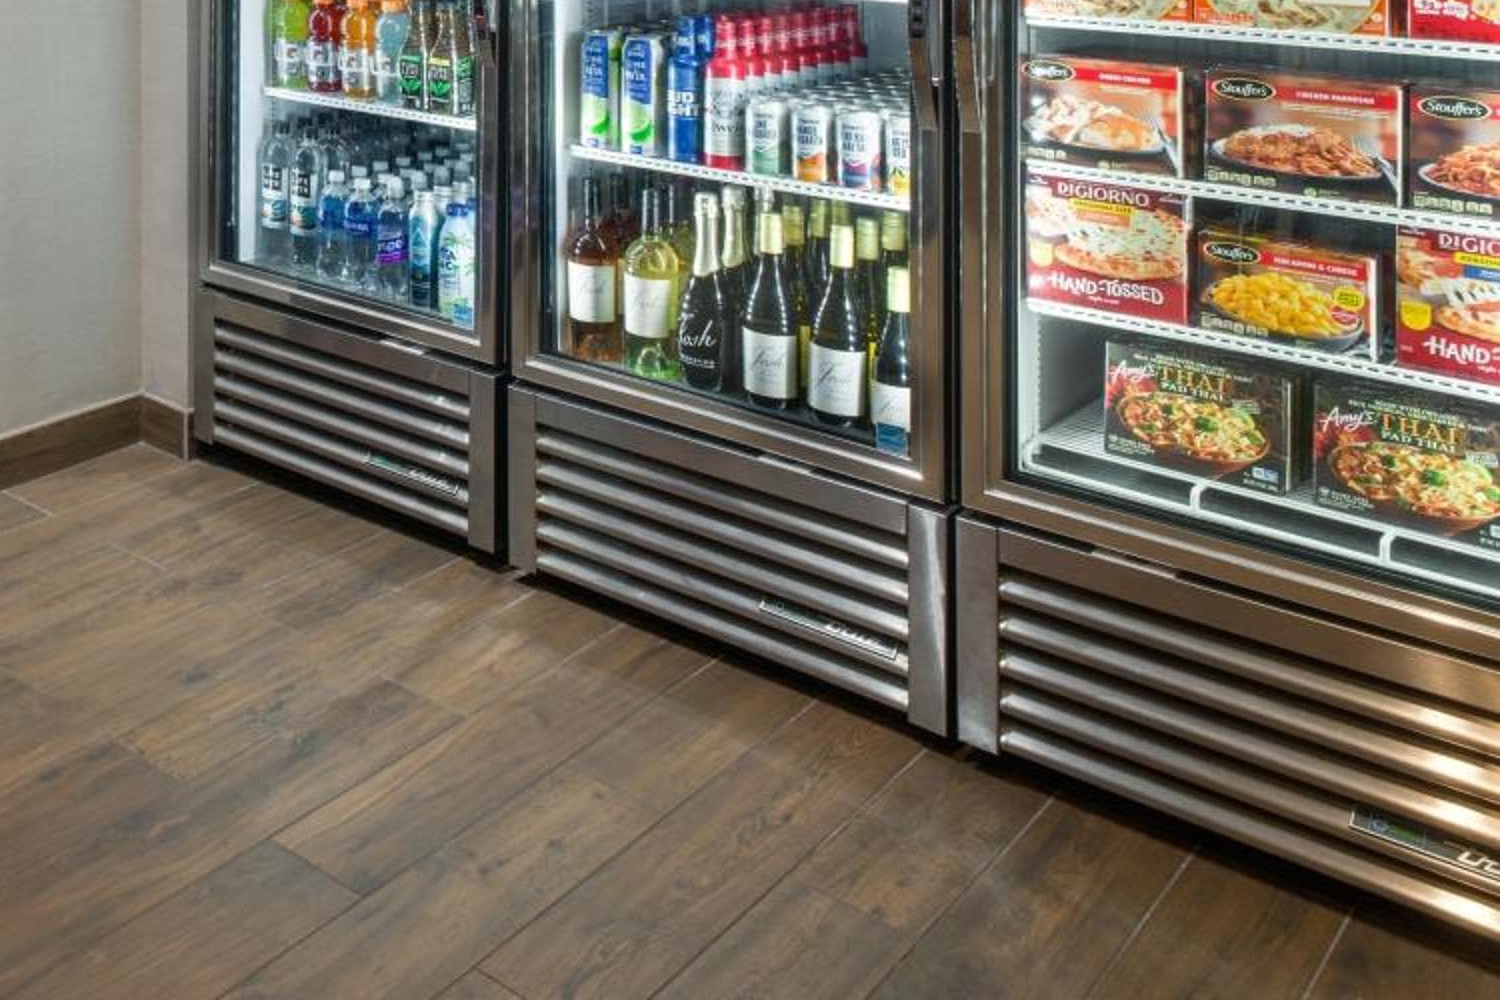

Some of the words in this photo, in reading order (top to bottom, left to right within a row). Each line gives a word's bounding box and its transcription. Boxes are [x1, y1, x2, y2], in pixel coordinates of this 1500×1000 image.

[1426, 98, 1485, 118] Stouffer's
[1056, 181, 1150, 208] DIGIORNO
[1047, 271, 1165, 305] HAND-TOSSED
[1111, 359, 1156, 385] Amy's
[1163, 365, 1231, 398] THAI
[1319, 406, 1376, 433] Amy's
[1380, 412, 1459, 446] THAI
[1381, 430, 1413, 445] PAD
[1417, 437, 1457, 454] THAI
